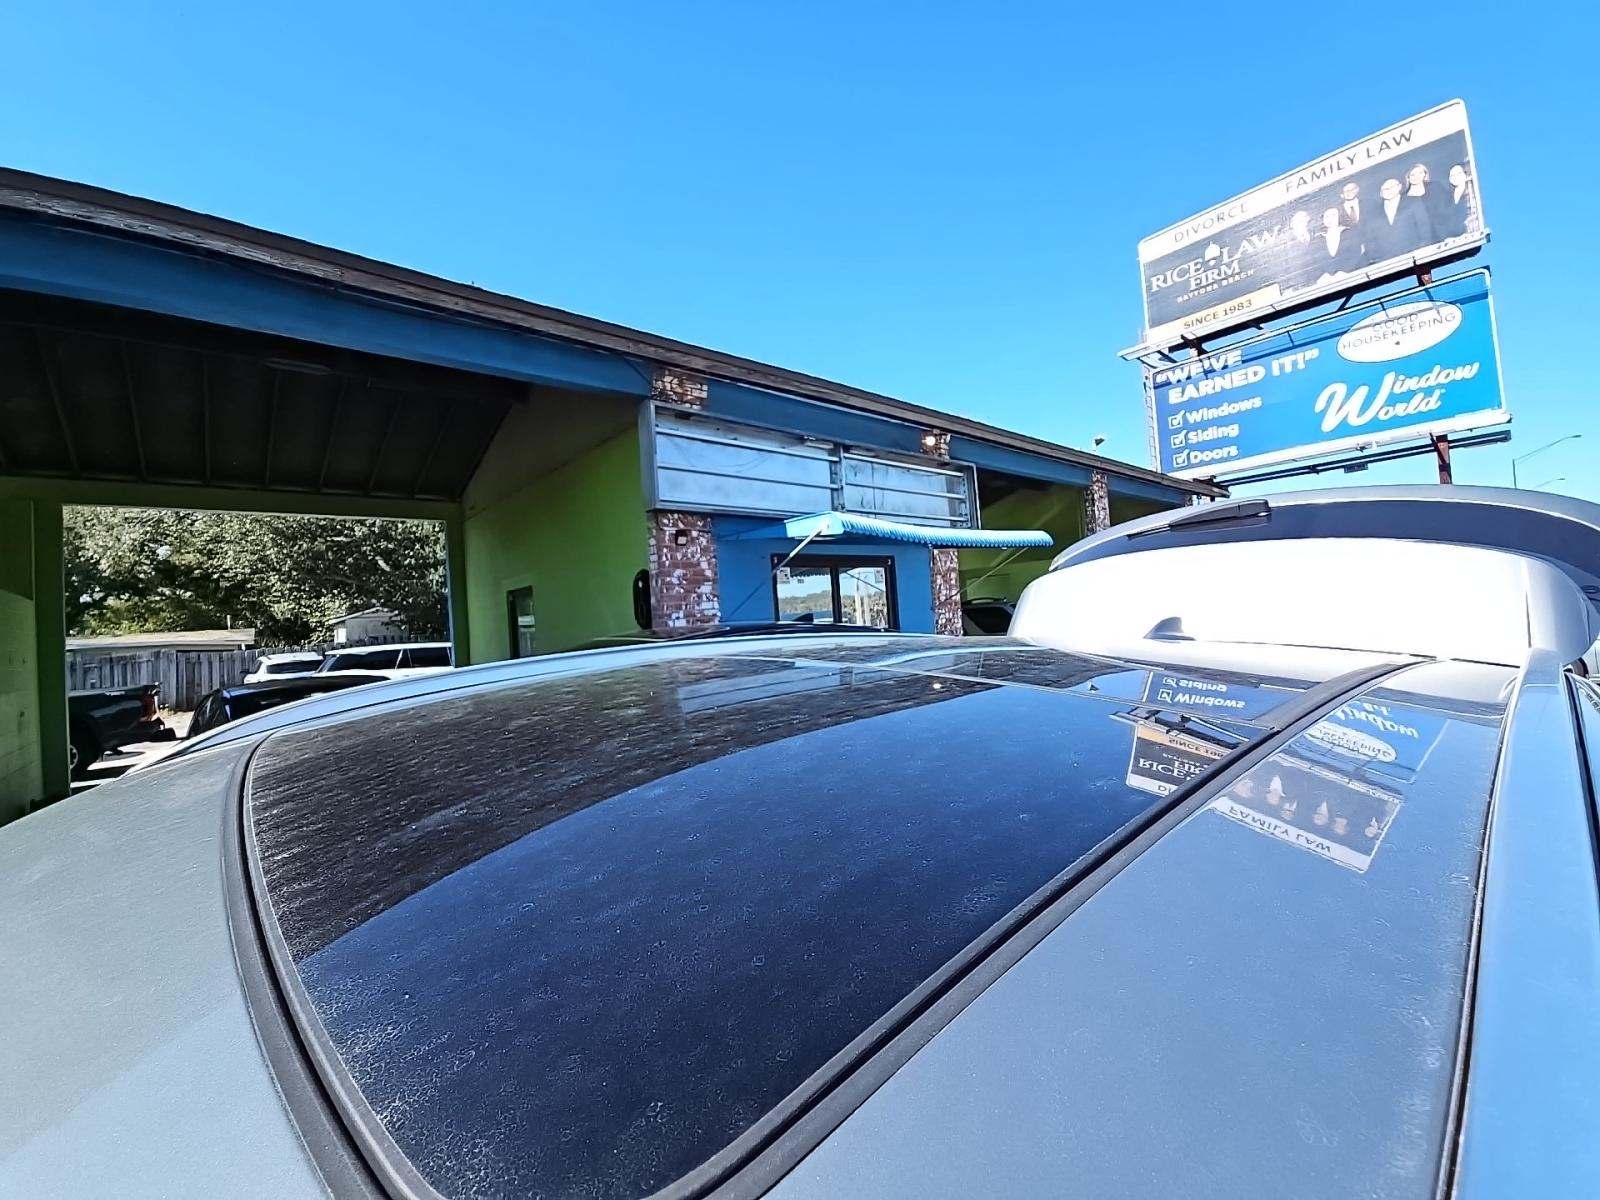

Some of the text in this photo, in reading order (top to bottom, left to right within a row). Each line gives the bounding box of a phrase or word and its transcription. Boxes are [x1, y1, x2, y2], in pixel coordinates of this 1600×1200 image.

[1285, 152, 1358, 193] FAMILY
[1366, 129, 1414, 159] LAW
[1150, 225, 1281, 292] RICE LAW
[1189, 260, 1241, 291] FIRM
[1177, 283, 1219, 303] DAYTONA
[1183, 299, 1253, 330] SINCE 1983
[1342, 312, 1457, 350] HOUSEKEEPING
[1169, 365, 1266, 405] EARNED
[1314, 361, 1480, 433] Window
[1186, 396, 1264, 424] Windows
[1188, 424, 1240, 445] Siding
[1190, 445, 1239, 464] Doors
